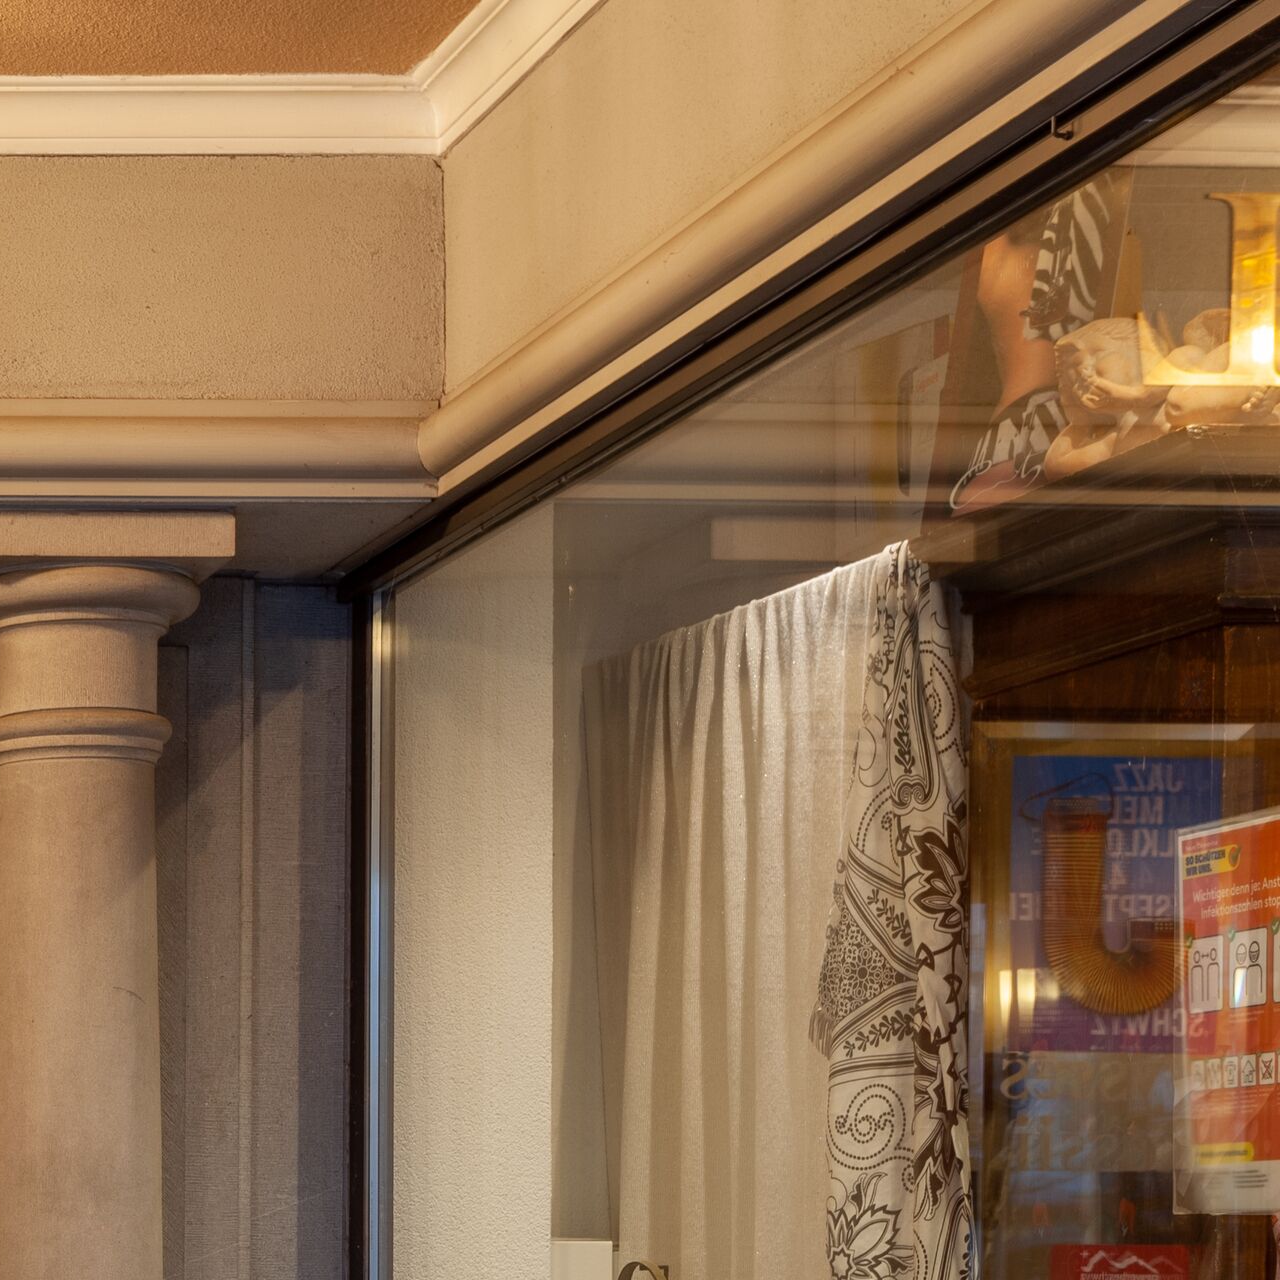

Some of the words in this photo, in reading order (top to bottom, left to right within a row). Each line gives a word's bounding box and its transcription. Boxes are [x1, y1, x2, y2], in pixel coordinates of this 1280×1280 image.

[1192, 886, 1230, 904] Wichtiger
[1231, 881, 1249, 897] denn
[1201, 898, 1263, 919] Infektionszahlen
